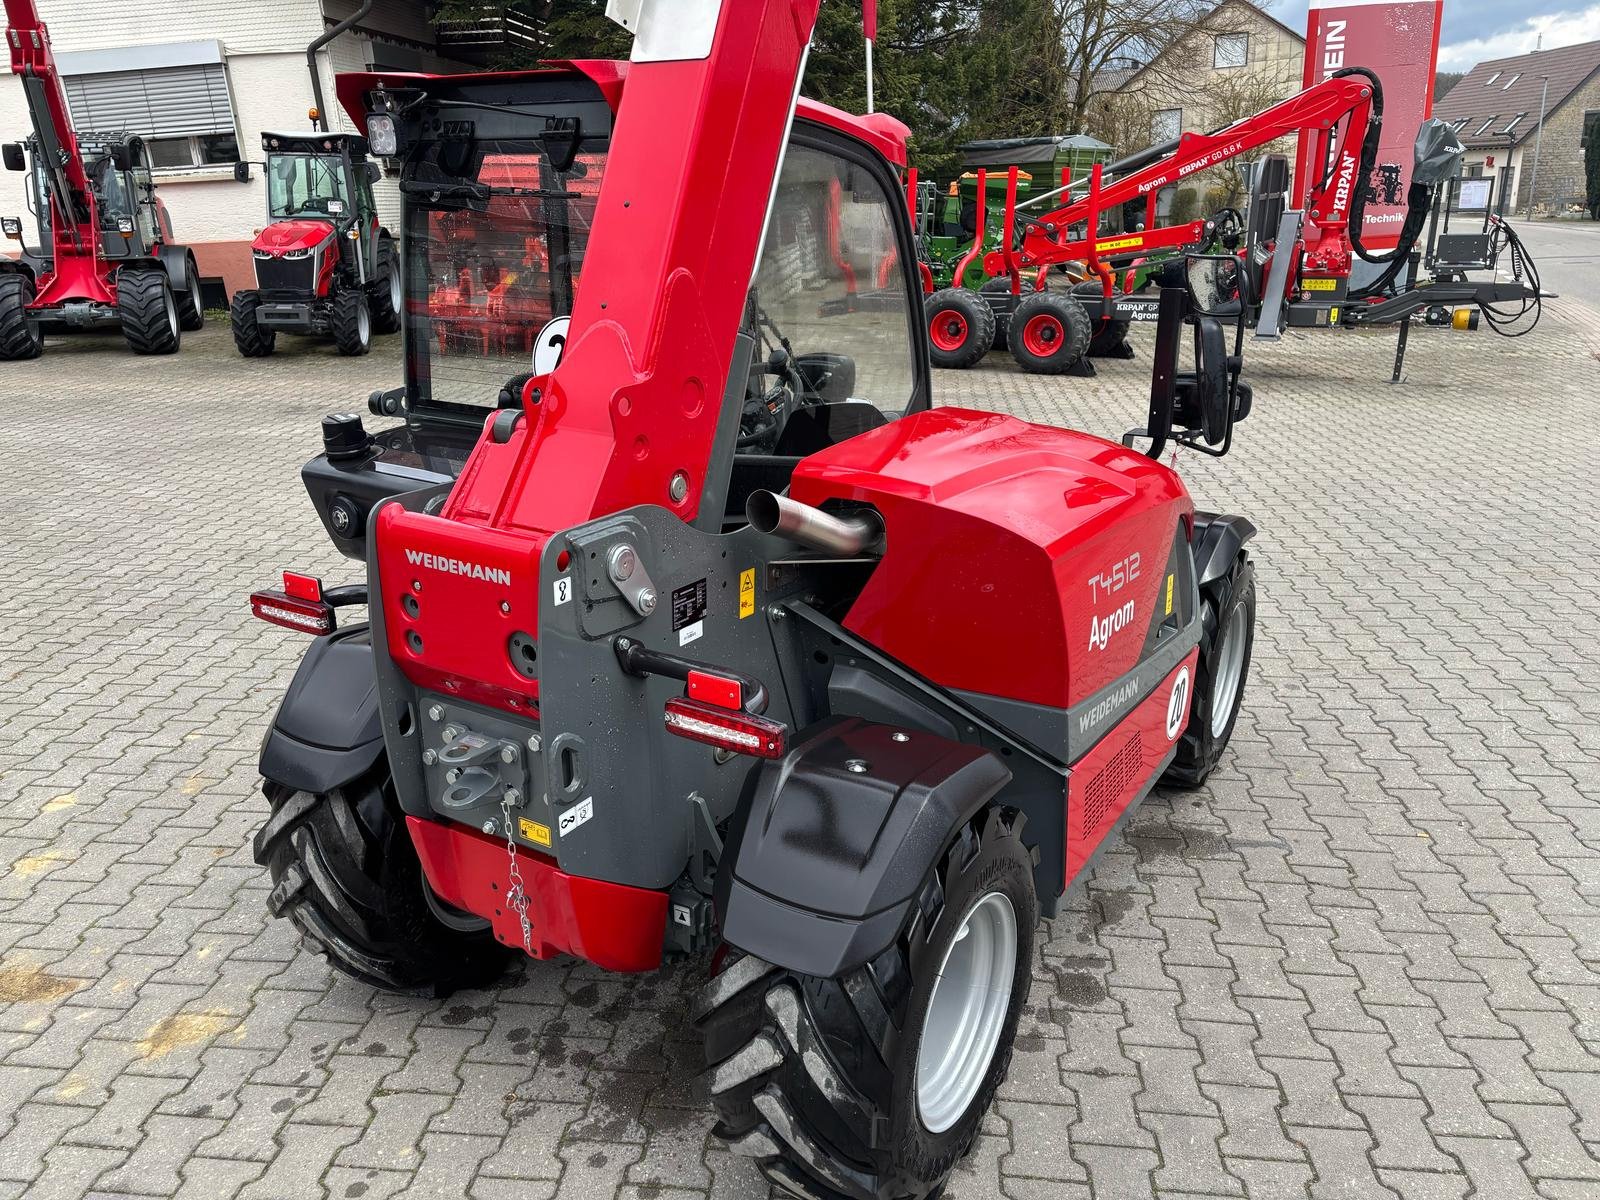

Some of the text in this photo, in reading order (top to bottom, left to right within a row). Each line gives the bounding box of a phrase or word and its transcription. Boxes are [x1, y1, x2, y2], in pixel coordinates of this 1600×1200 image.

[1211, 149, 1223, 161] GD
[1236, 141, 1243, 150] K
[1138, 175, 1167, 193] Agrom
[405, 548, 511, 587] WEIDEMANN
[1088, 551, 1140, 605] T4512
[1088, 599, 1135, 652] Agrom
[1079, 676, 1139, 734] WEIDEMANN
[1169, 677, 1186, 731] 20
